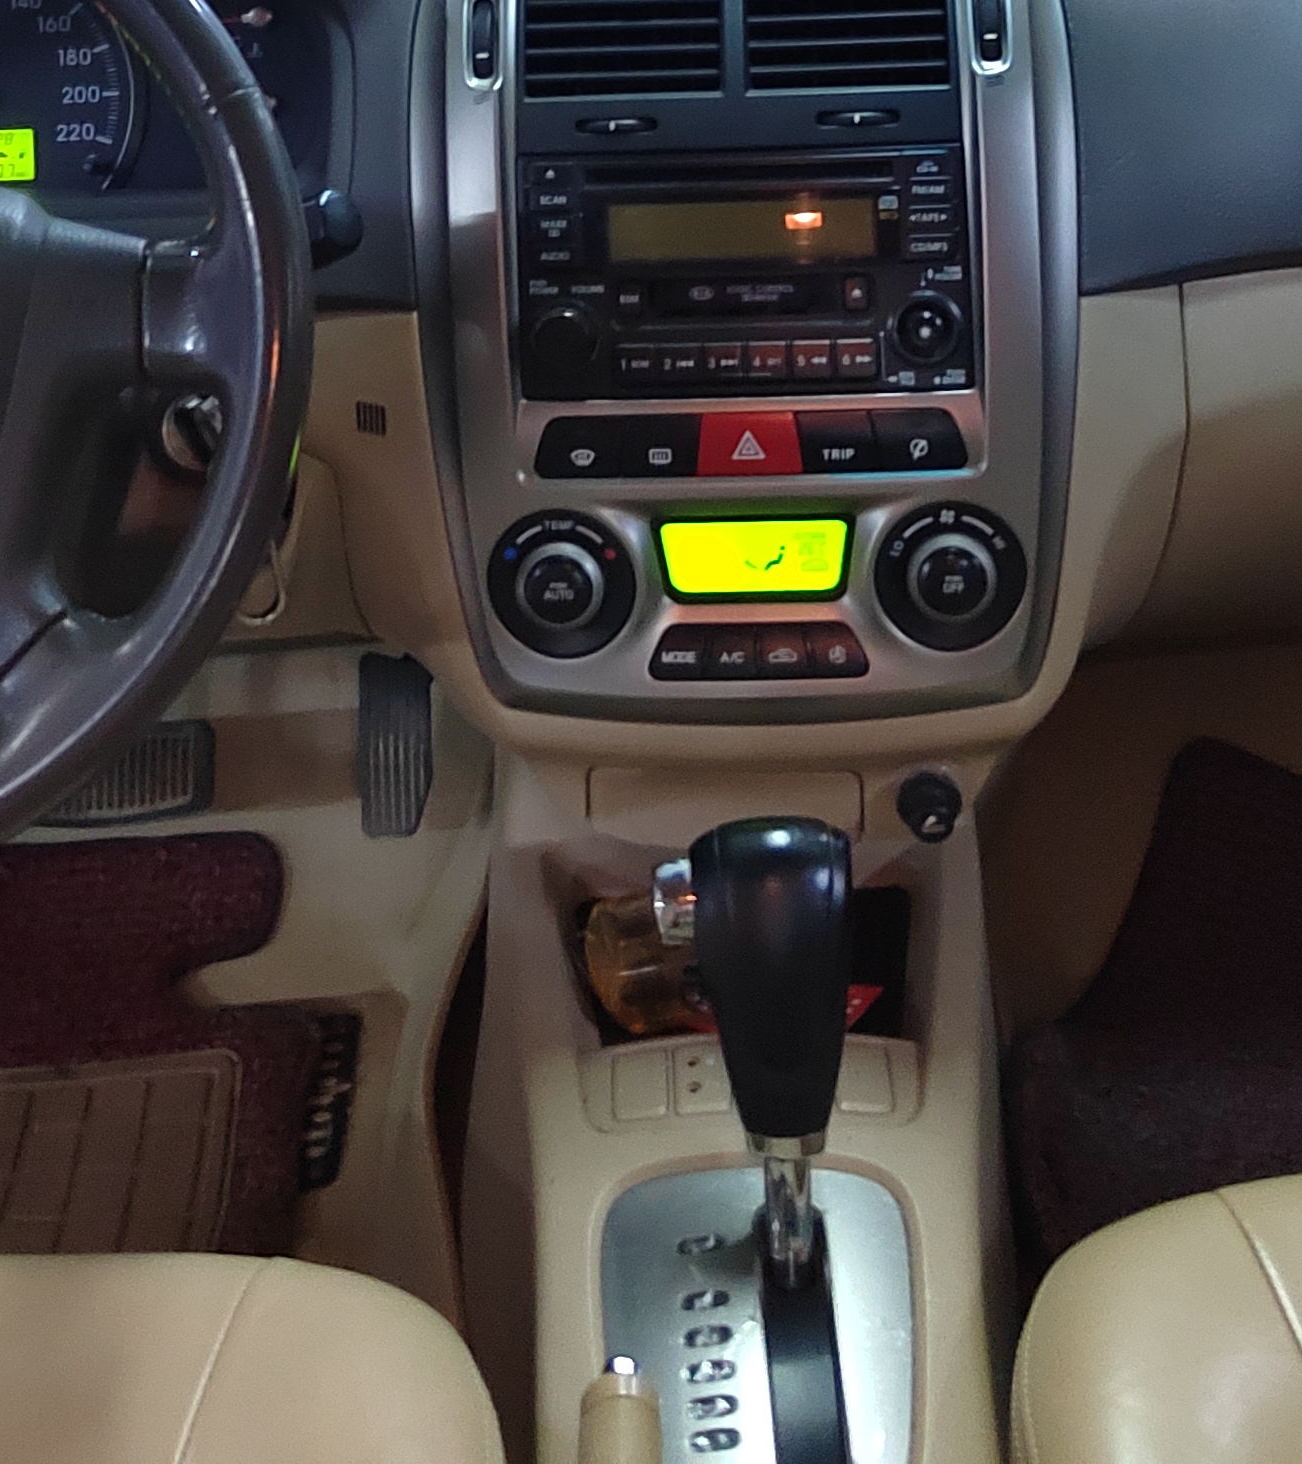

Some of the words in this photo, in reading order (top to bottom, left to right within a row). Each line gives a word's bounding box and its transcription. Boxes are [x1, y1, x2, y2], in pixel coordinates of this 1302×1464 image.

[38, 15, 71, 34] 160
[58, 48, 92, 66] 180
[62, 86, 100, 104] 200
[56, 123, 94, 142] 220
[822, 448, 855, 461] TRIP
[544, 589, 574, 600] AUTO
[661, 651, 696, 663] MODE
[719, 651, 745, 663] A/C
